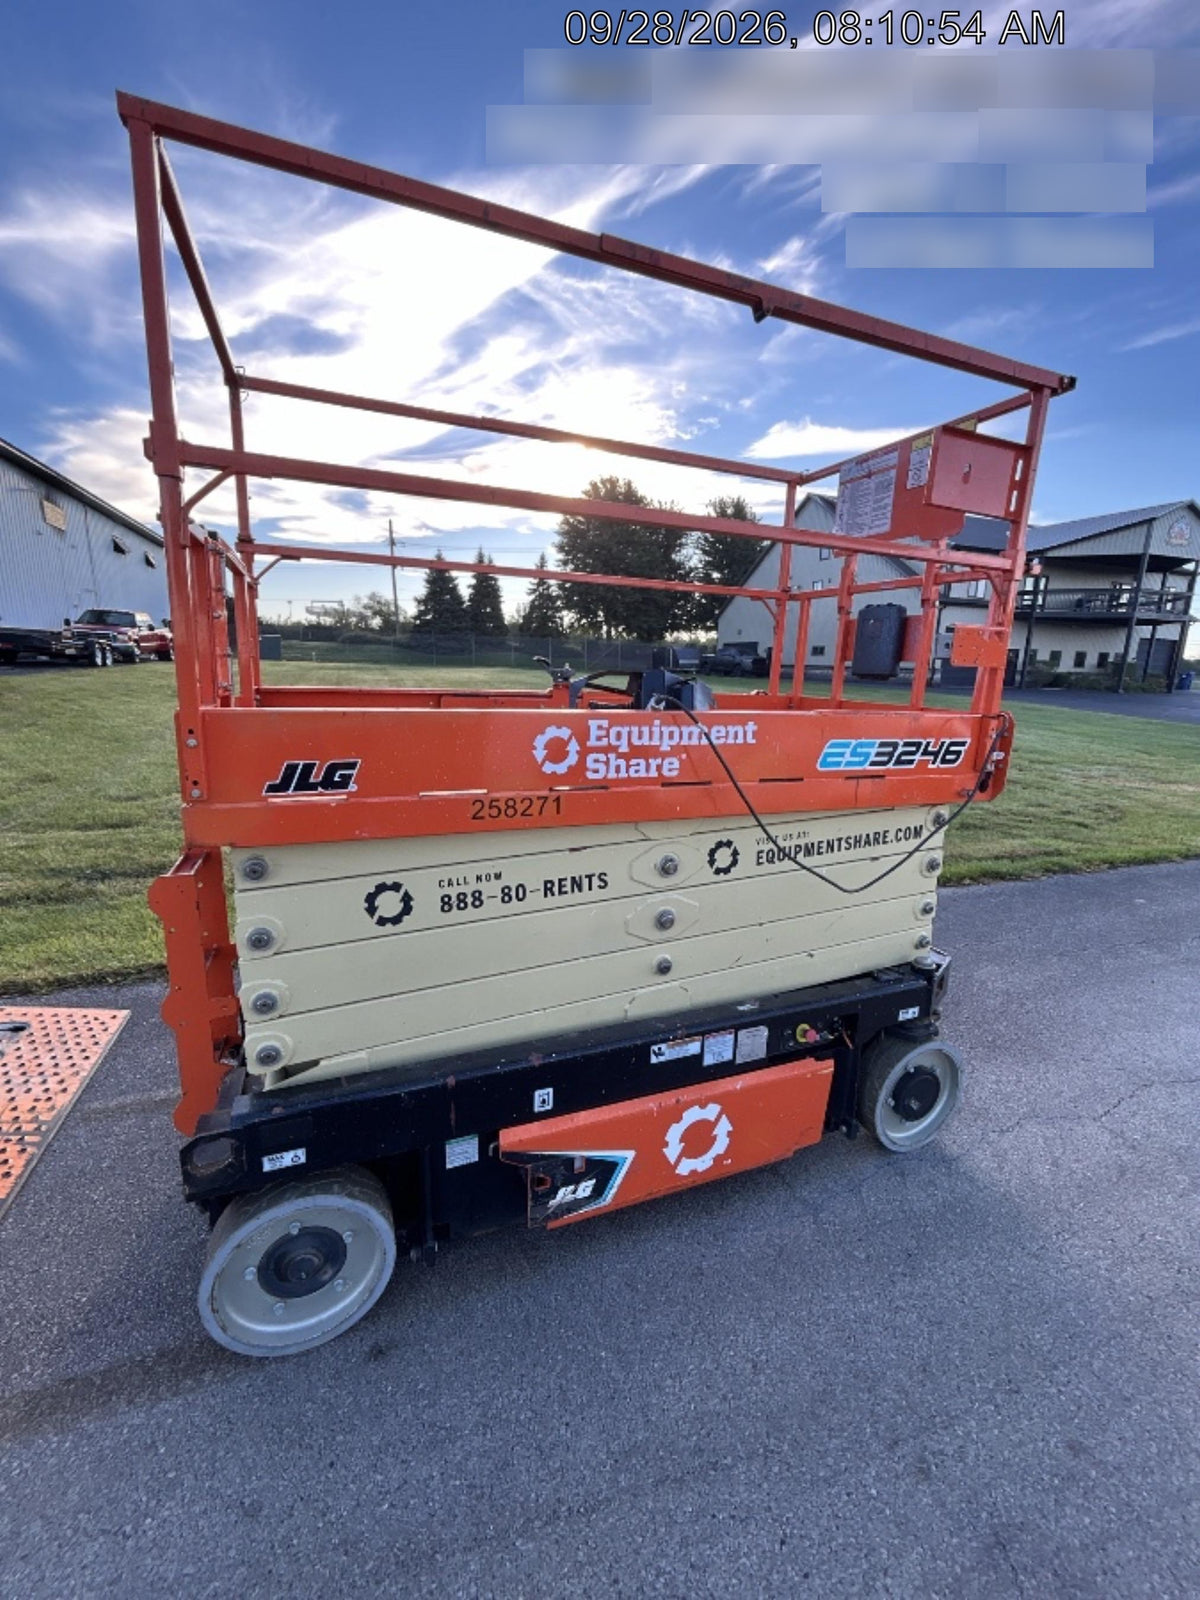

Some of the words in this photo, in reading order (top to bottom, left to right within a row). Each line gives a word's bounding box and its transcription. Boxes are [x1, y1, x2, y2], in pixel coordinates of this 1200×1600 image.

[586, 719, 758, 752] Equipment
[585, 753, 681, 780] Share
[816, 738, 971, 771] ES3246
[262, 758, 362, 796] JLG
[471, 796, 563, 820] 258271
[755, 835, 779, 846] VIST
[756, 824, 924, 867] EQUIPMENTSHARE.COM
[438, 875, 470, 889] CALL
[475, 871, 503, 884] NOW
[439, 871, 609, 914] 888-80-RENTS
